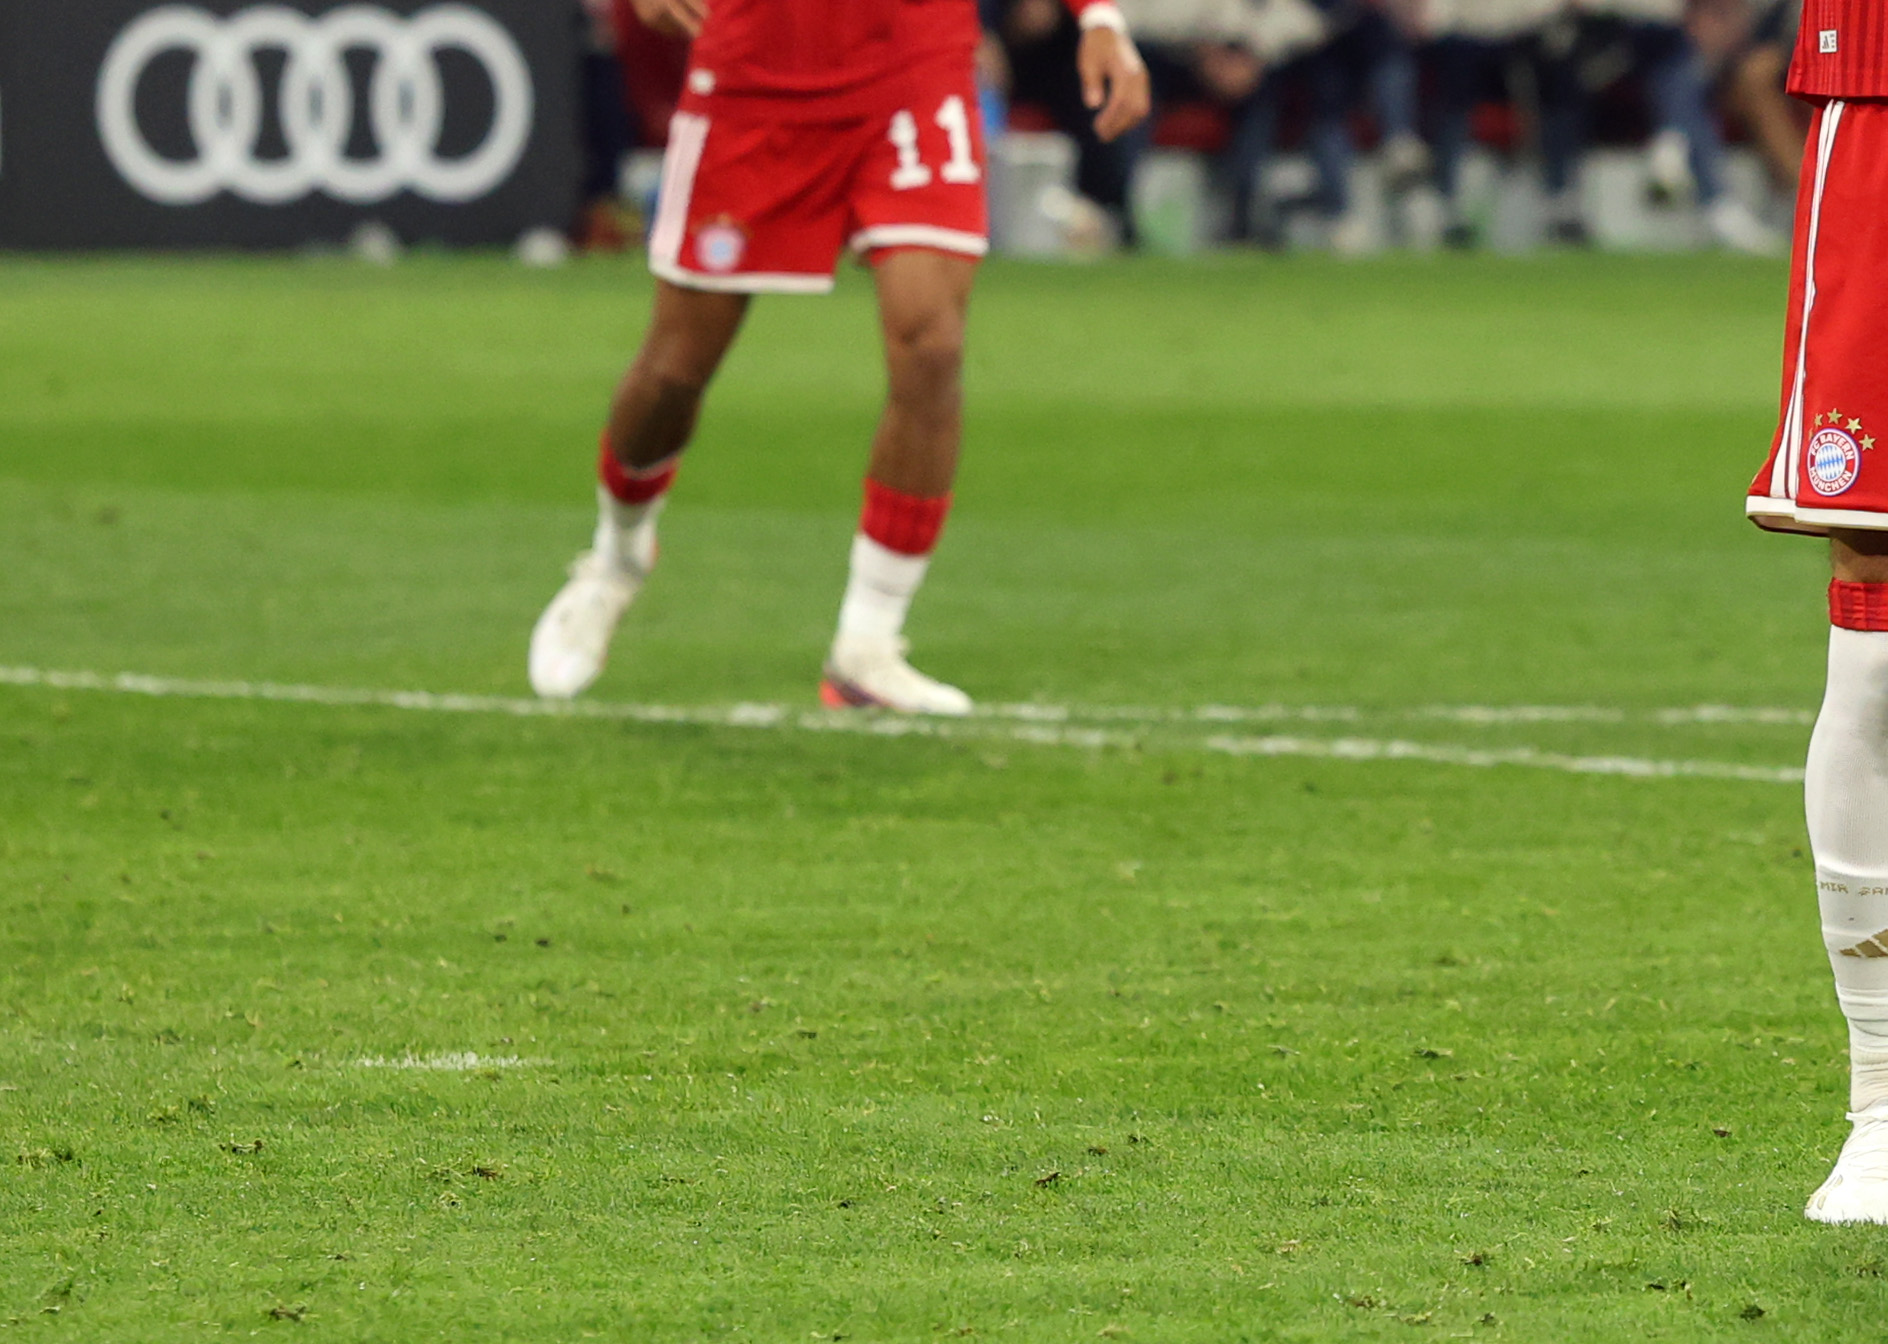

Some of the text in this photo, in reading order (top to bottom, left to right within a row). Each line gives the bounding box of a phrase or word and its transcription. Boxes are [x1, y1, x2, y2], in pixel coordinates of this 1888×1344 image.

[888, 96, 981, 190] 11
[1811, 434, 1854, 460] FC BAYERN
